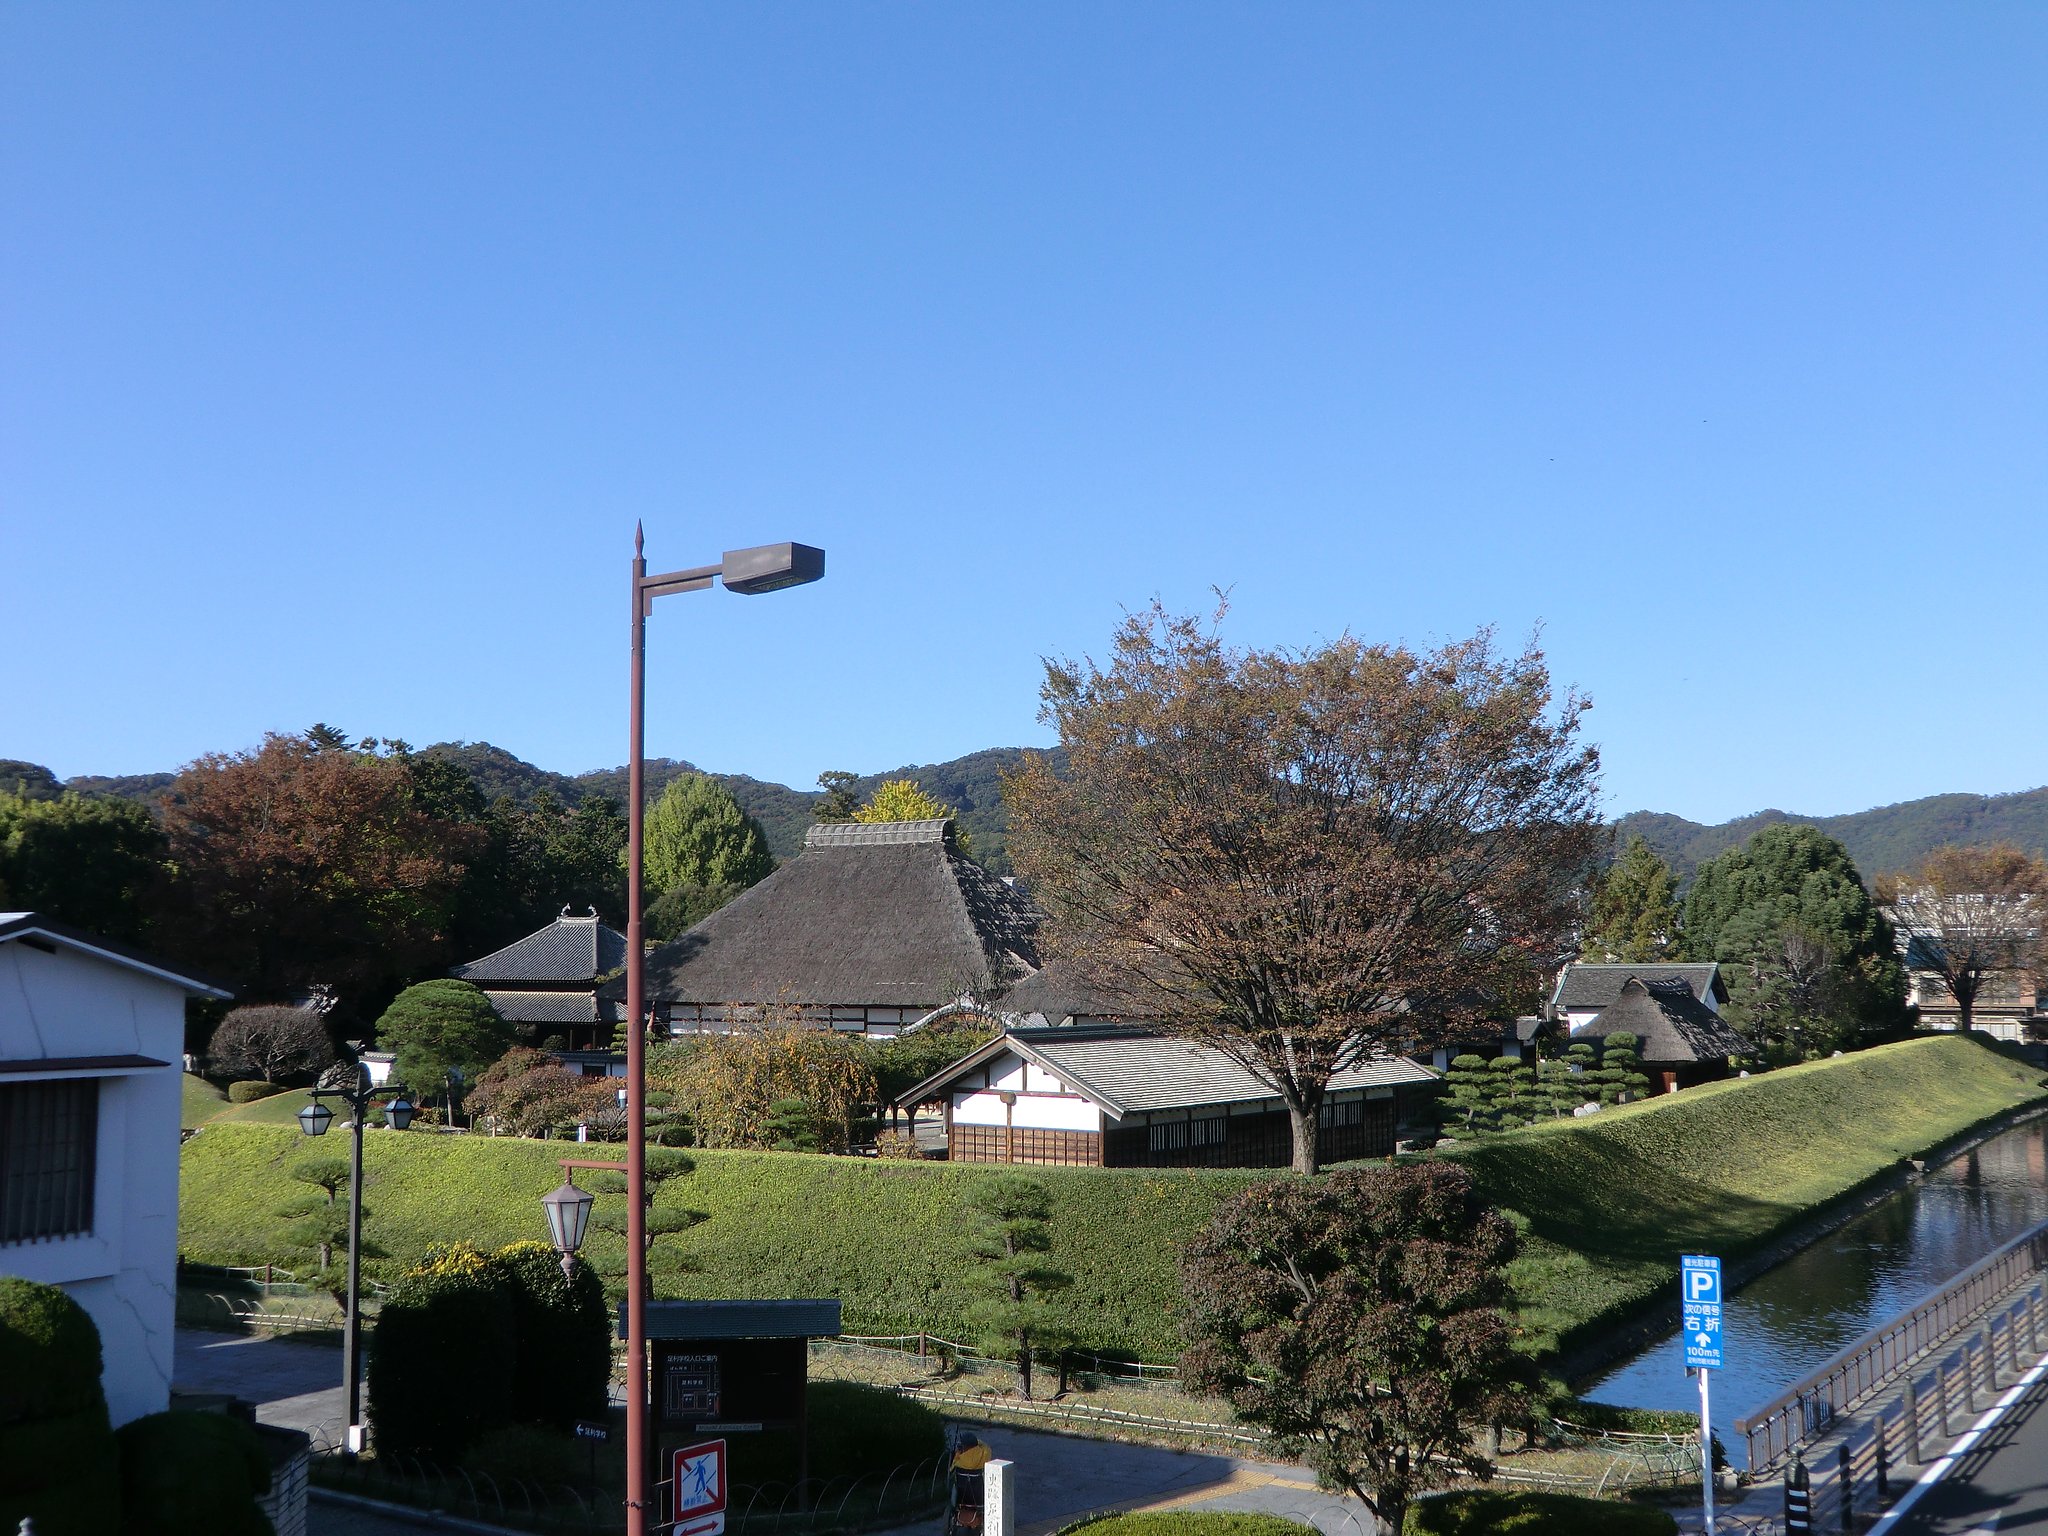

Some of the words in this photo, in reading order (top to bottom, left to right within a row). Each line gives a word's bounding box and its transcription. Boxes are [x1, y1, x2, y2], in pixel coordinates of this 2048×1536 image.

[1691, 1272, 1713, 1300] P
[1685, 1304, 1720, 1316] 次の信号
[1685, 1316, 1720, 1333] 右折
